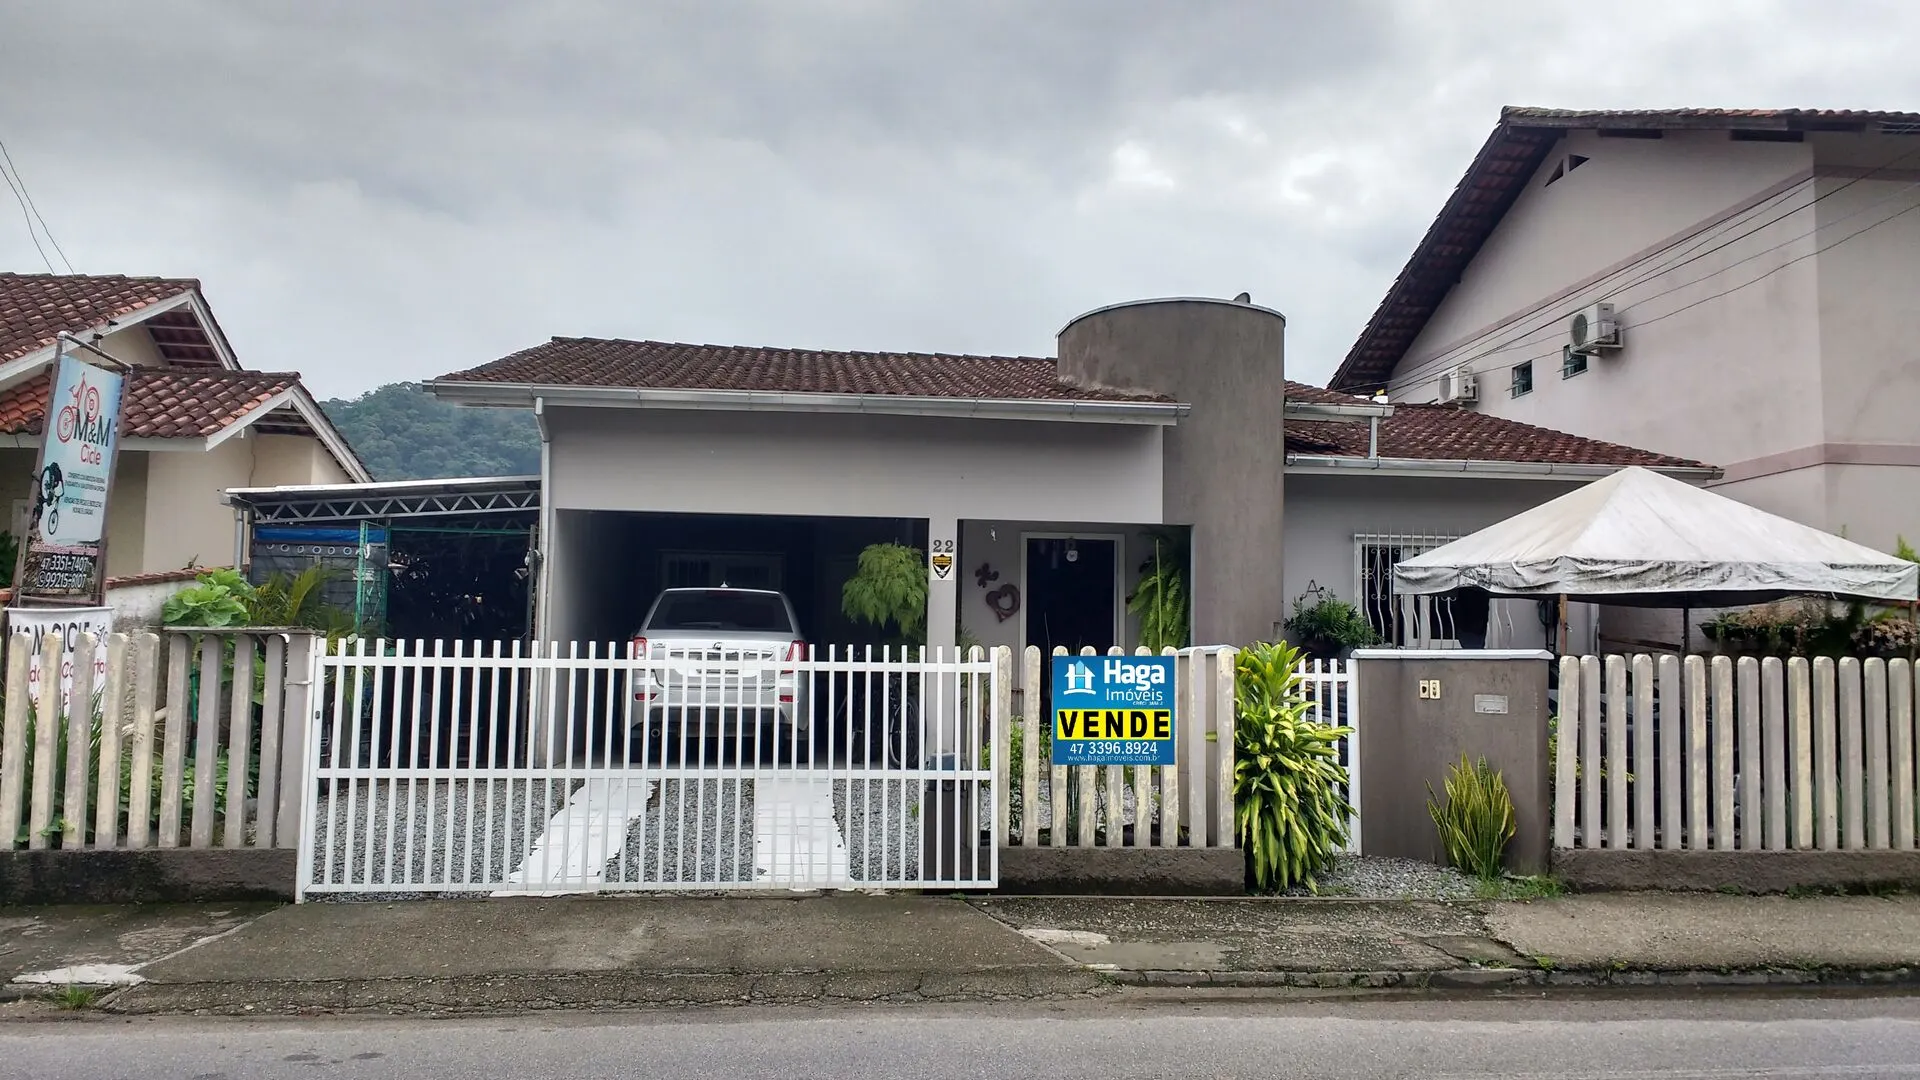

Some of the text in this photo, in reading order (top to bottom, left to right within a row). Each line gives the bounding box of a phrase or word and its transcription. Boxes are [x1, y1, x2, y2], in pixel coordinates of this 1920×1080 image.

[73, 408, 111, 447] M&M
[81, 443, 101, 465] Cicle
[933, 539, 954, 553] 22
[41, 555, 89, 571] 47 3351-7407
[1104, 660, 1166, 691] Haga
[1106, 688, 1163, 701] Imóveis
[1059, 711, 1170, 738] VENDE
[1070, 741, 1158, 755] 47 3396.8924
[1067, 754, 1160, 763] www.hagaimoveis.com.br
